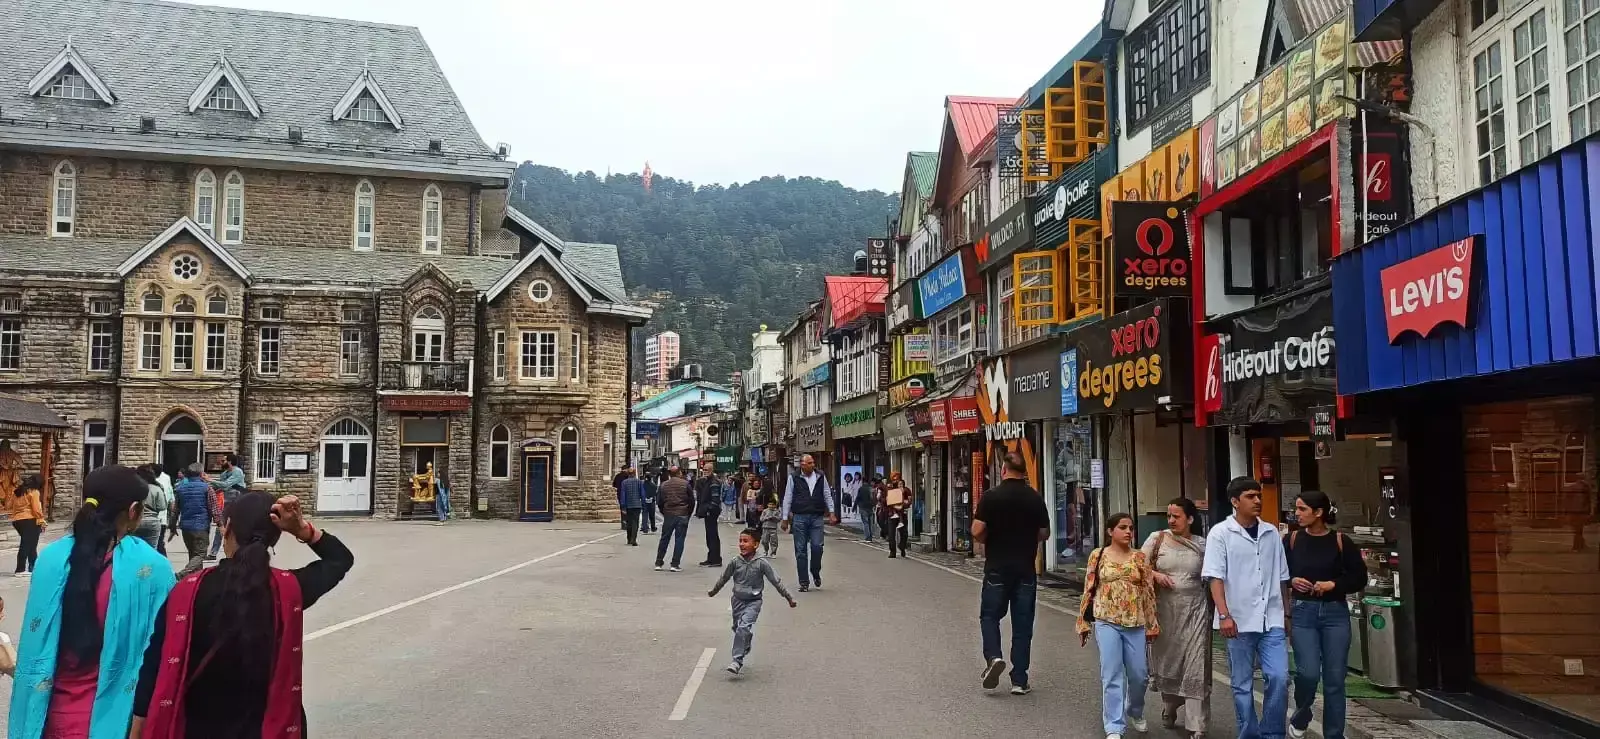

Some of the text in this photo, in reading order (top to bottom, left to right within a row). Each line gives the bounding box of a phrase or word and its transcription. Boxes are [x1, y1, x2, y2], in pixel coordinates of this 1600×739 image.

[1066, 180, 1089, 206] bake
[1355, 211, 1398, 221] Hdeout
[1124, 257, 1188, 276] xero
[1124, 273, 1187, 290] degrees
[1111, 315, 1161, 358] xero
[1222, 325, 1336, 383] Hideout Café
[1079, 353, 1163, 408] degrees
[953, 408, 977, 419] SHREE
